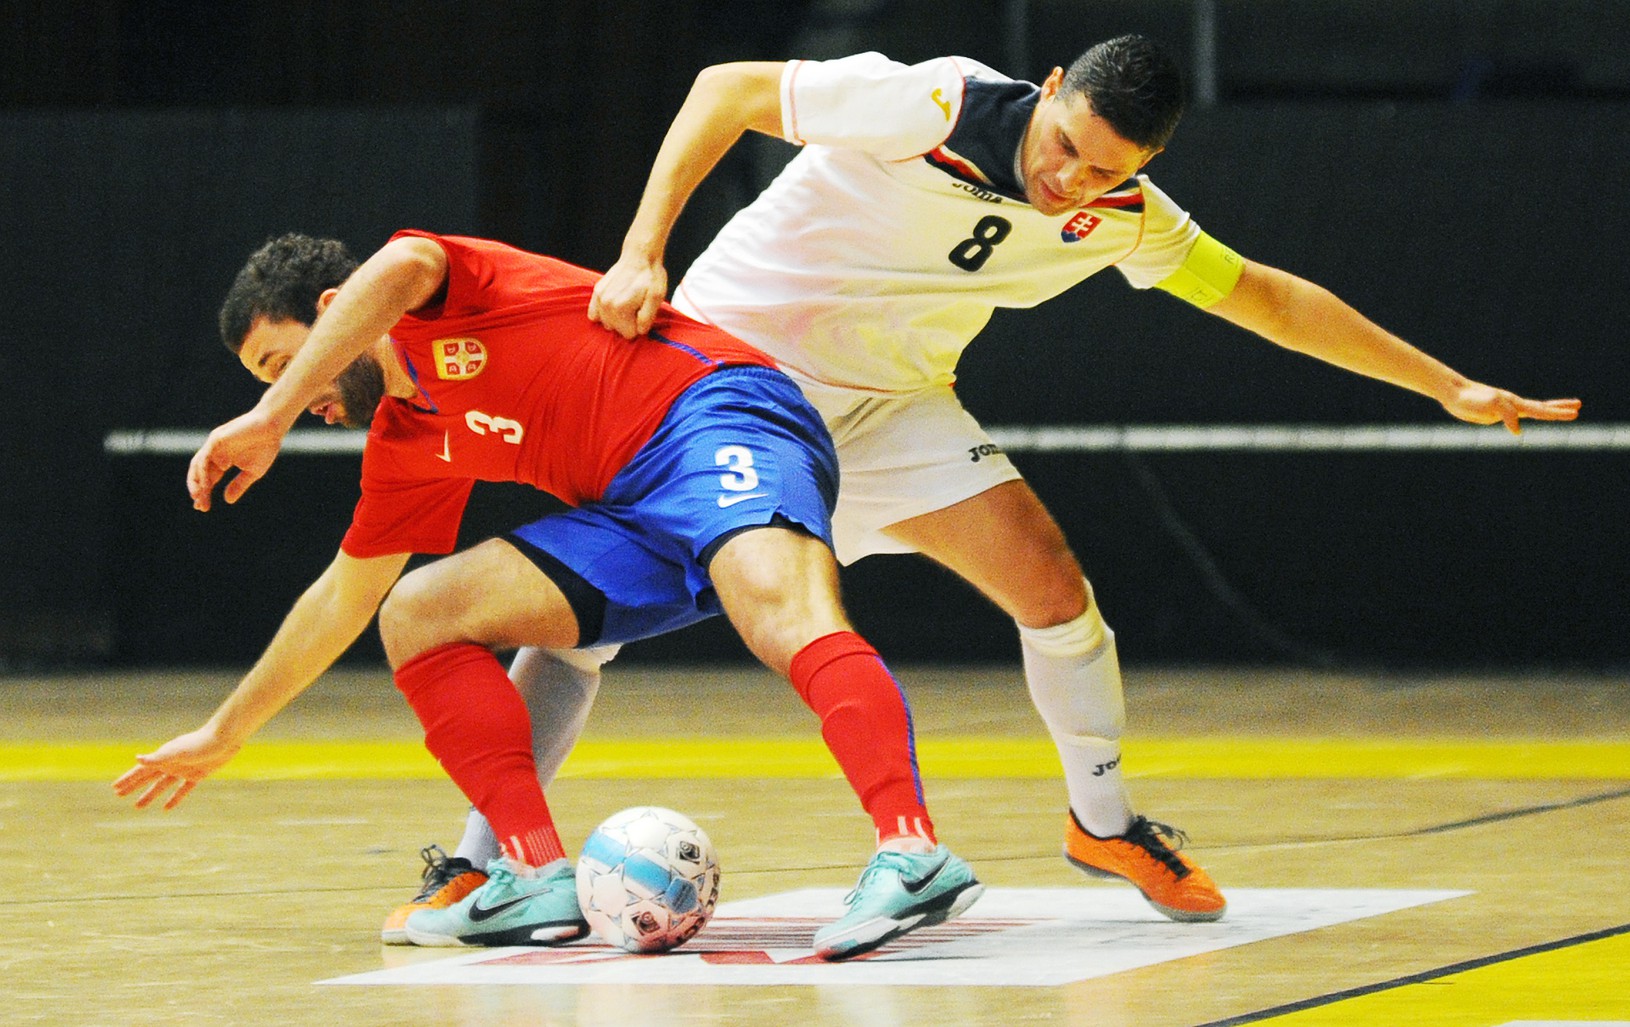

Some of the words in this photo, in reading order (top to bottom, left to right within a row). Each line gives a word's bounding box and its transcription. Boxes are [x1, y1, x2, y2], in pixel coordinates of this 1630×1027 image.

[948, 215, 1012, 271] 8
[465, 410, 524, 444] 3
[714, 445, 759, 491] 3
